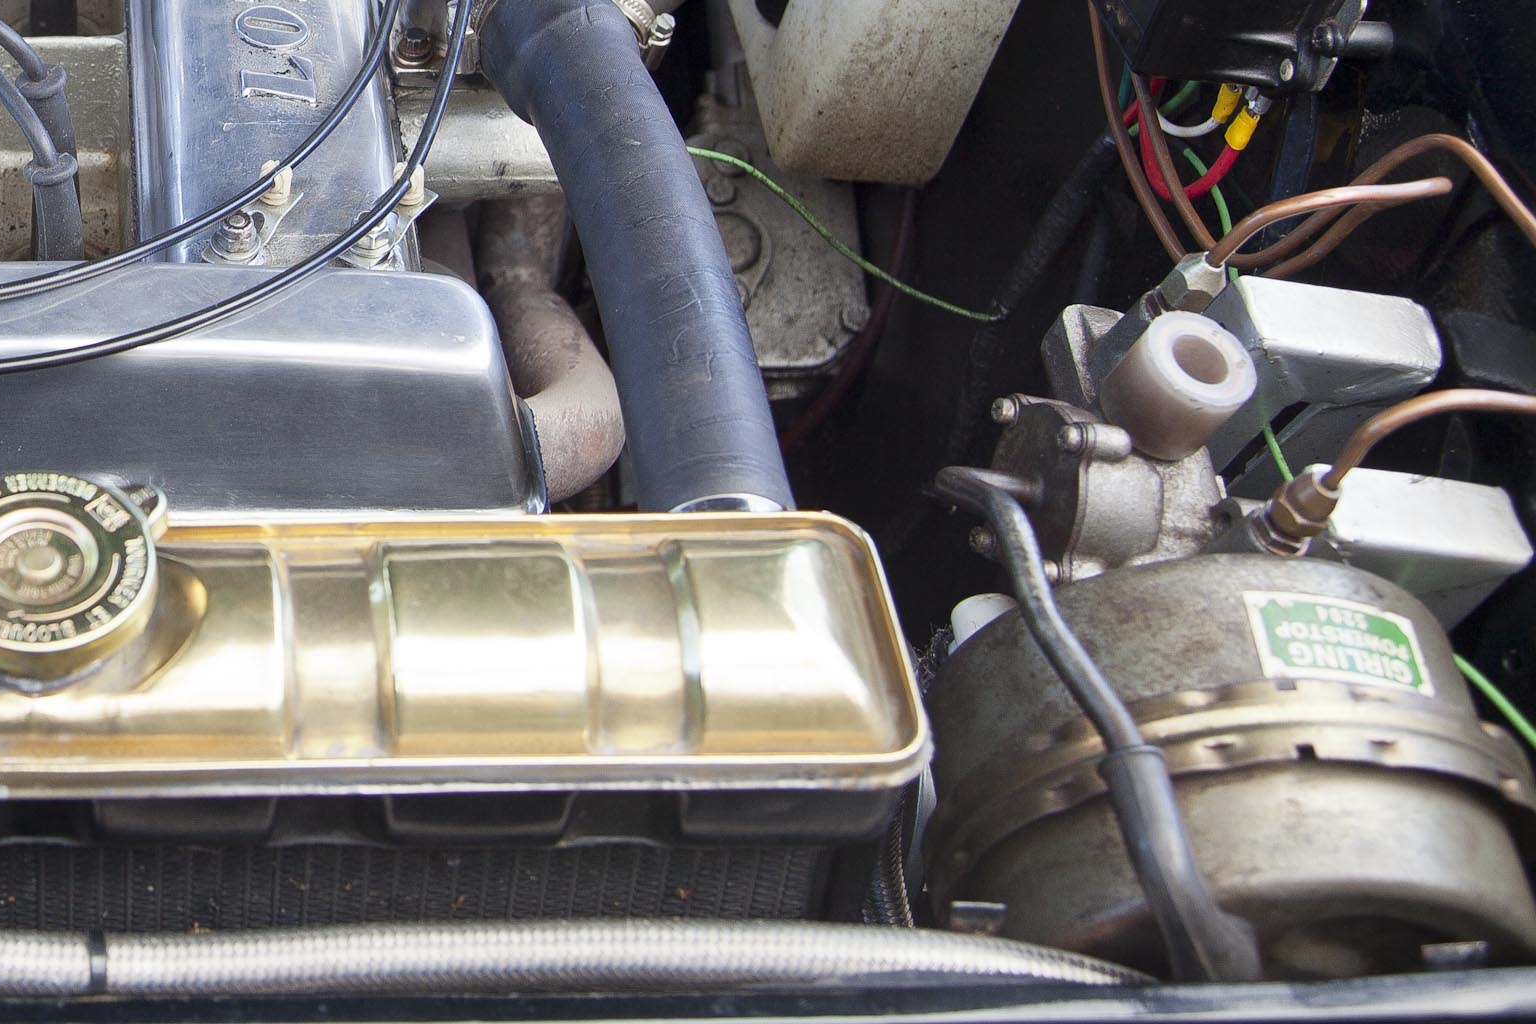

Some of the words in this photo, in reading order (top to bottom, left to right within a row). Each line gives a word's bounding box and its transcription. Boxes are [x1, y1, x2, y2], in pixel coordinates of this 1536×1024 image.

[84, 605, 113, 630] ET
[1275, 622, 1409, 661] POWERSTOP
[1287, 641, 1414, 684] GIRLING
